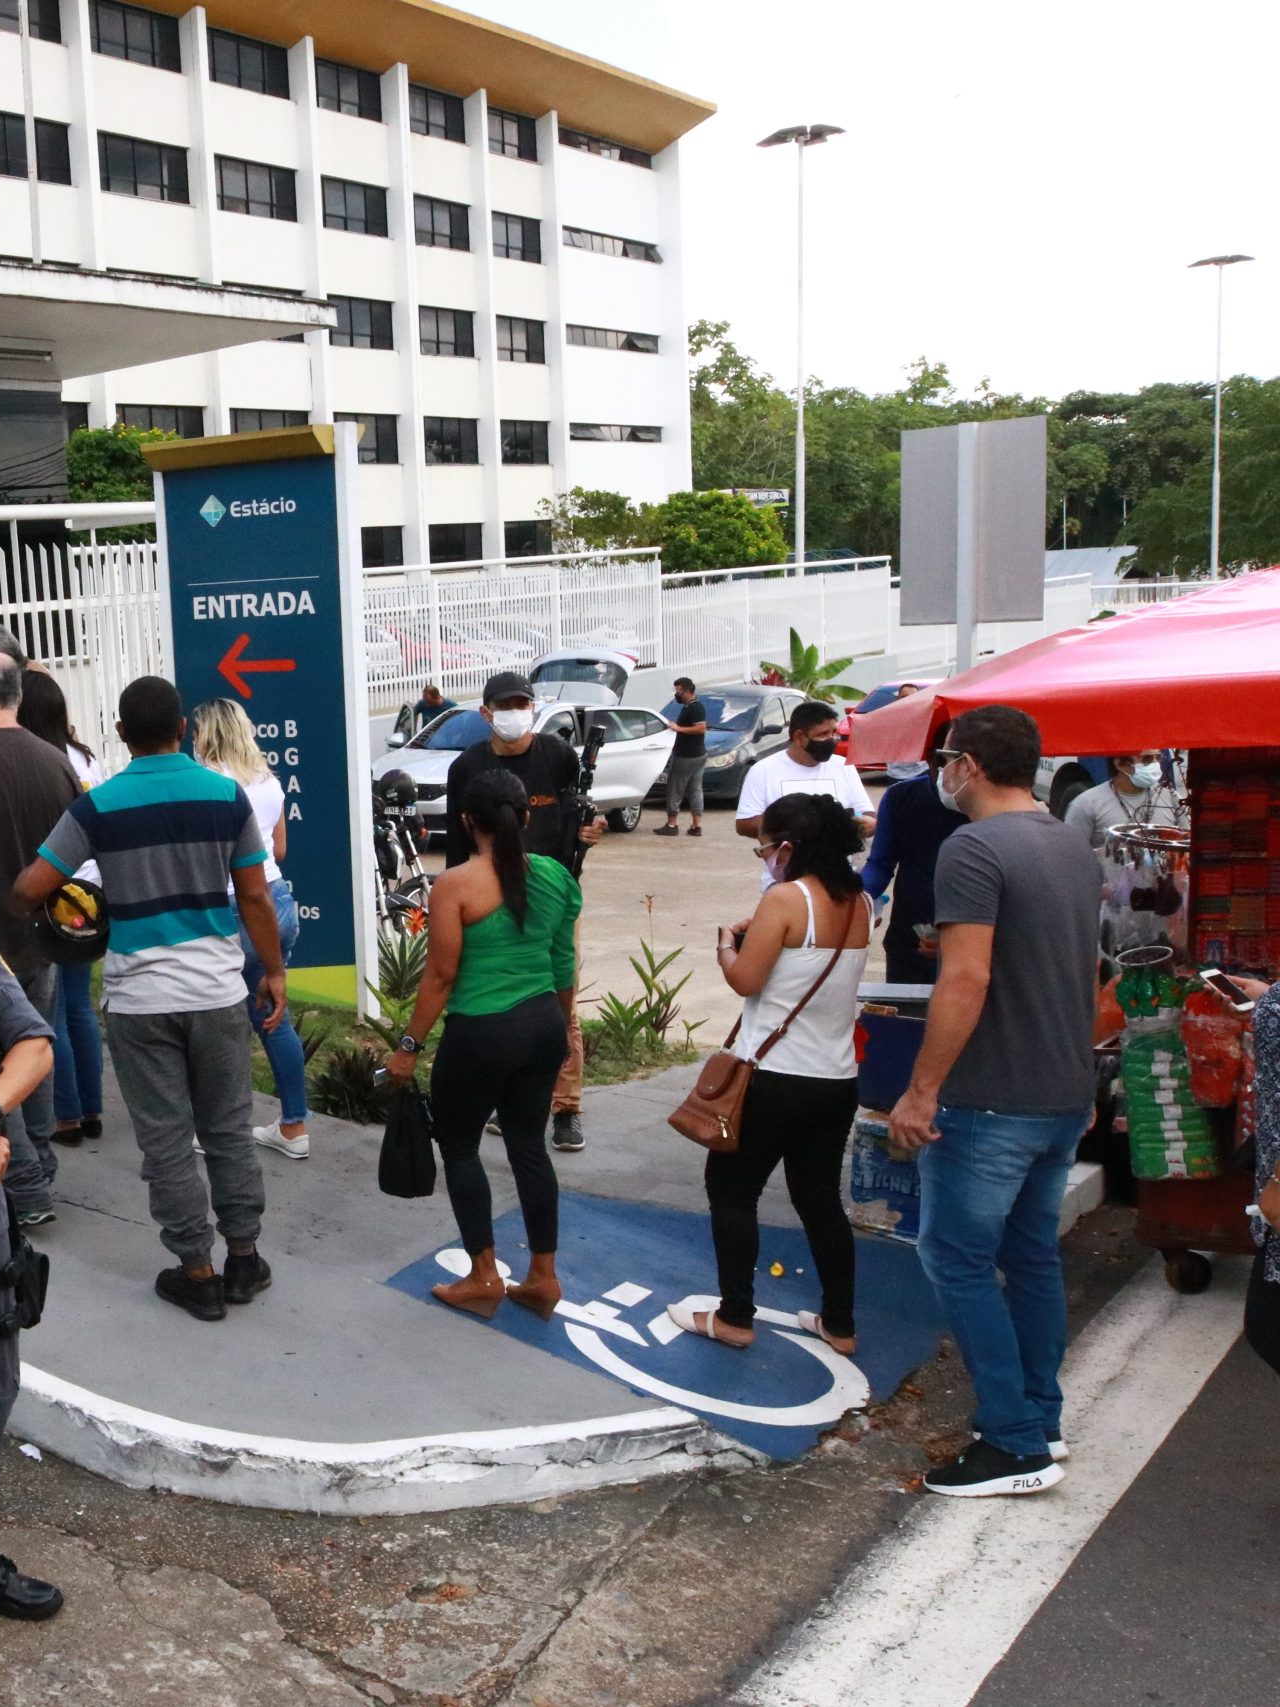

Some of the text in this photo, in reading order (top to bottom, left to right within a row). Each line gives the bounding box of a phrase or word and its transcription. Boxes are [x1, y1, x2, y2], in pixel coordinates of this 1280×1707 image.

[230, 496, 297, 518] Estácio
[192, 590, 316, 620] ENTRADA
[284, 719, 298, 738] B
[284, 747, 299, 766] G
[287, 775, 301, 793] A
[288, 802, 303, 820] A
[1012, 1477, 1043, 1489] FILA
